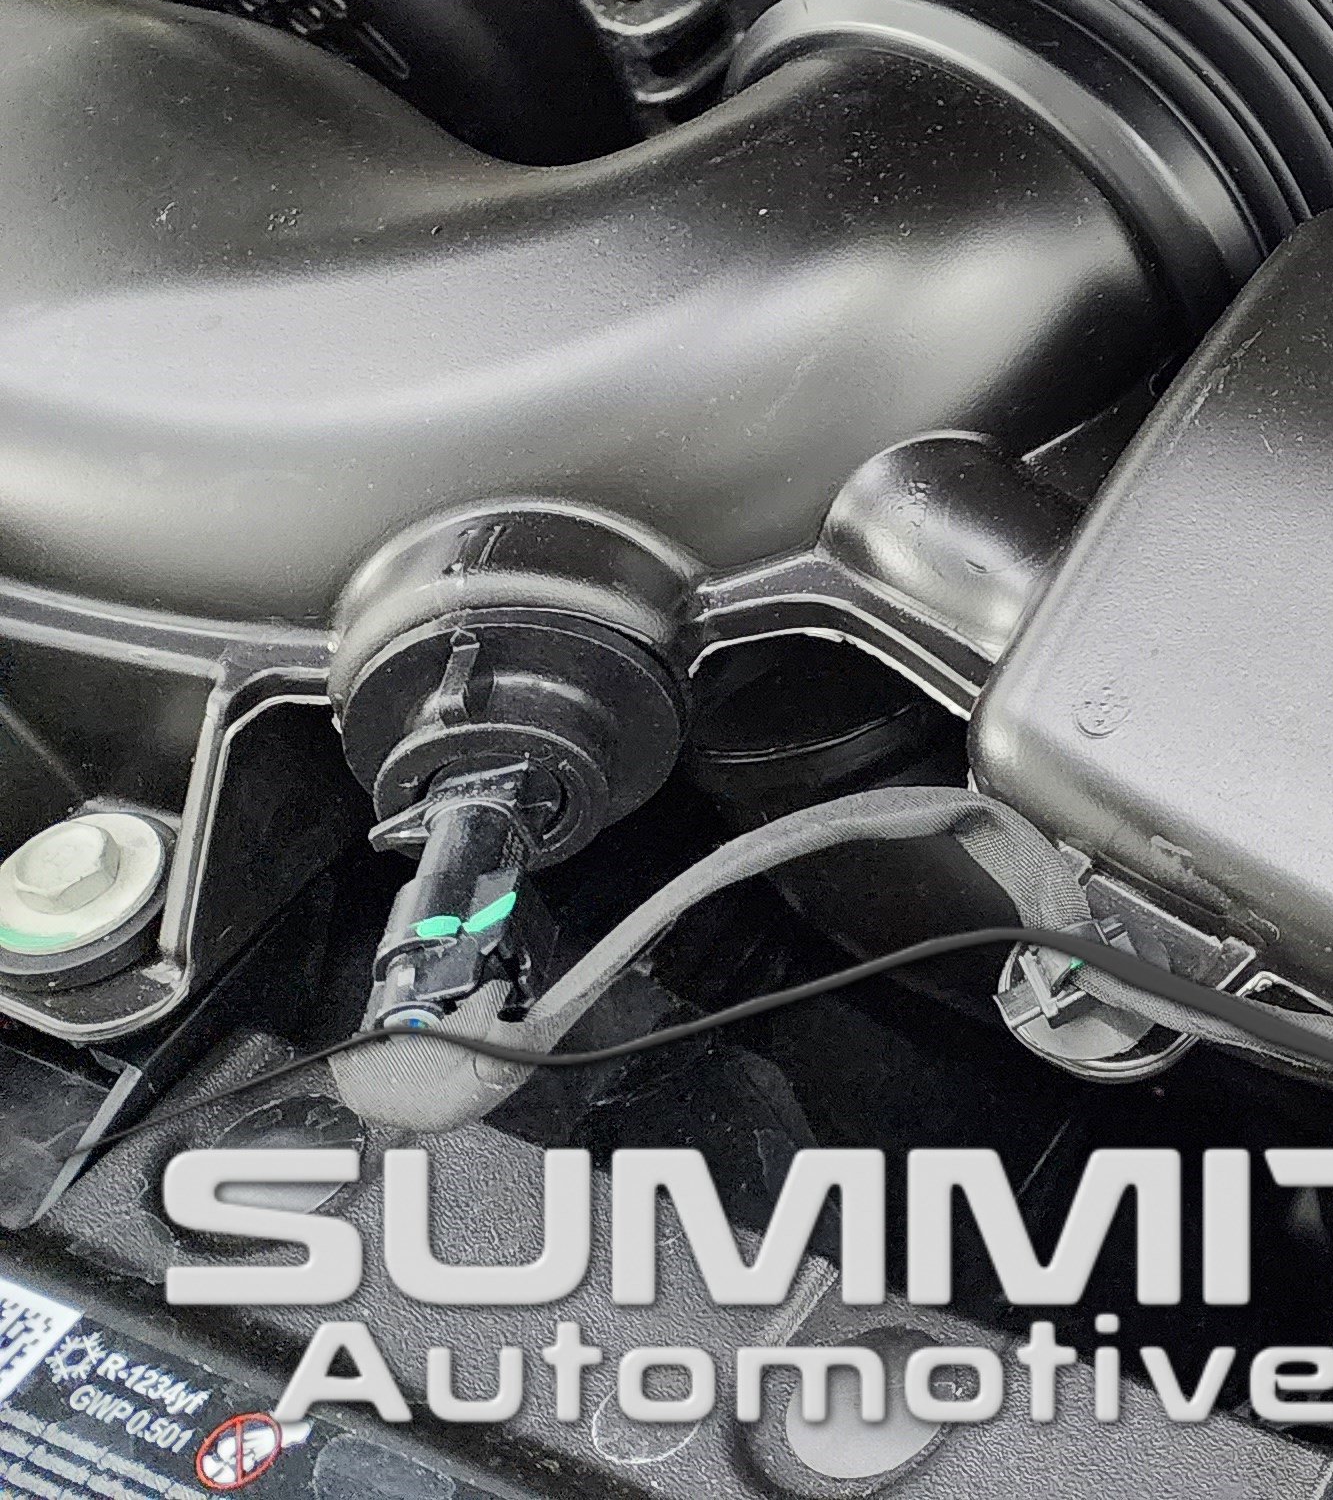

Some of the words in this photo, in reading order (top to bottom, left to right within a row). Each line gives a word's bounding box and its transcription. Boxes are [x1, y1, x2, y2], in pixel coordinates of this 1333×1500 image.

[97, 1352, 213, 1416] R-1234yf
[69, 1384, 135, 1425] GWP
[125, 1409, 197, 1454] 0.501
